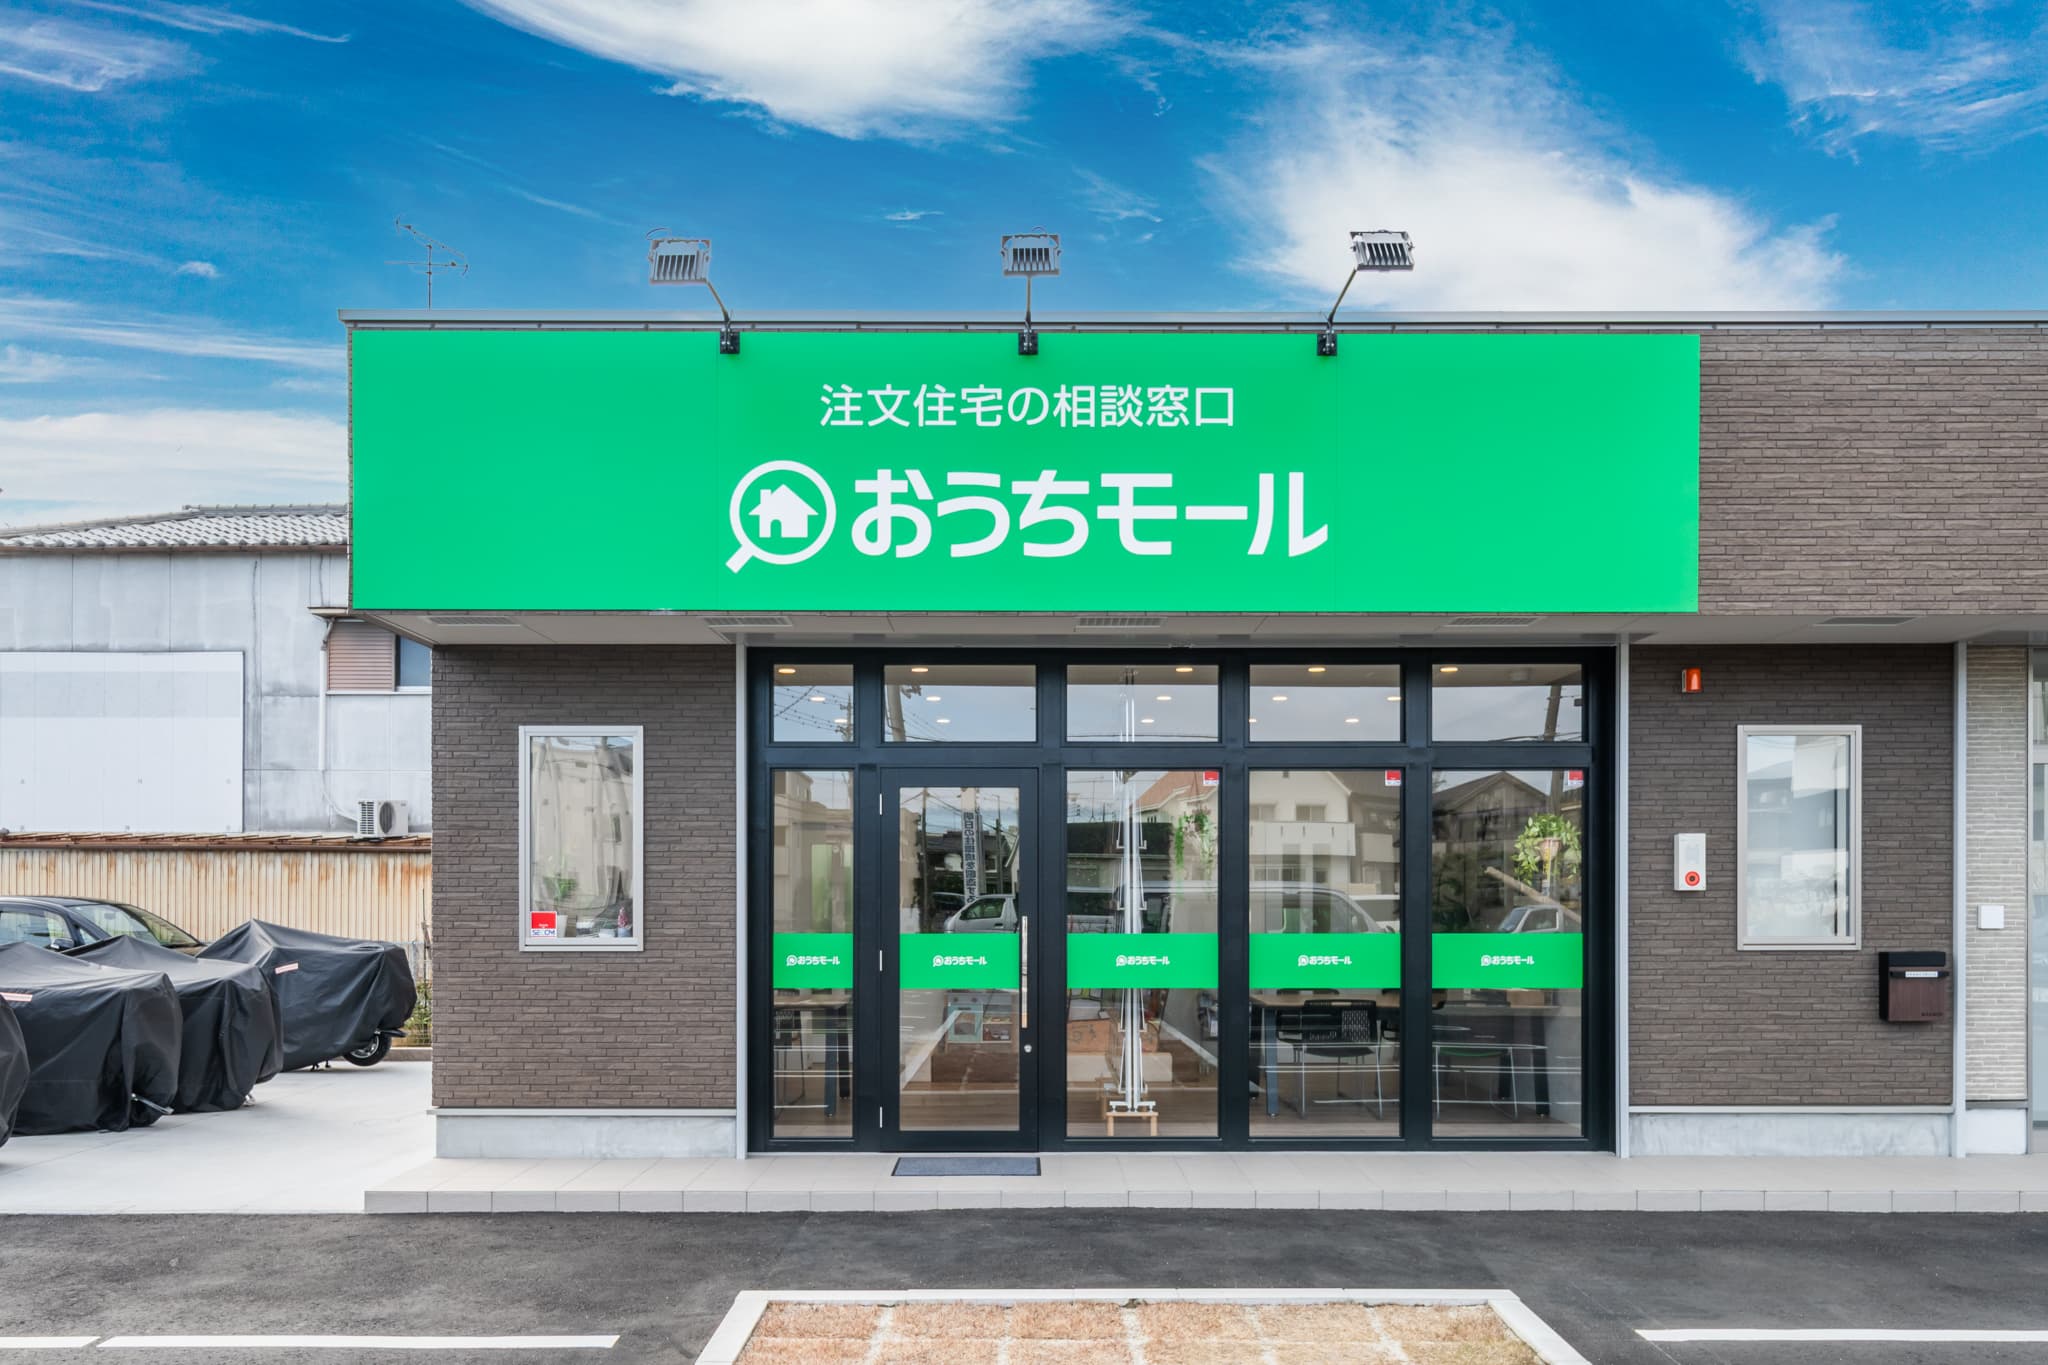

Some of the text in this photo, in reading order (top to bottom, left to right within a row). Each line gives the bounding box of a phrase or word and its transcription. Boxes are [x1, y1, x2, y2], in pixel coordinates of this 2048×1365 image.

[820, 383, 1235, 428] 注文住宅の相談窓口
[851, 469, 1328, 558] おうちモール
[797, 955, 840, 966] おうちモール
[944, 955, 988, 966] おうちモール
[1127, 955, 1170, 966] おうちモール
[1309, 955, 1352, 966] おうちモール
[1491, 955, 1535, 966] おうちモール
